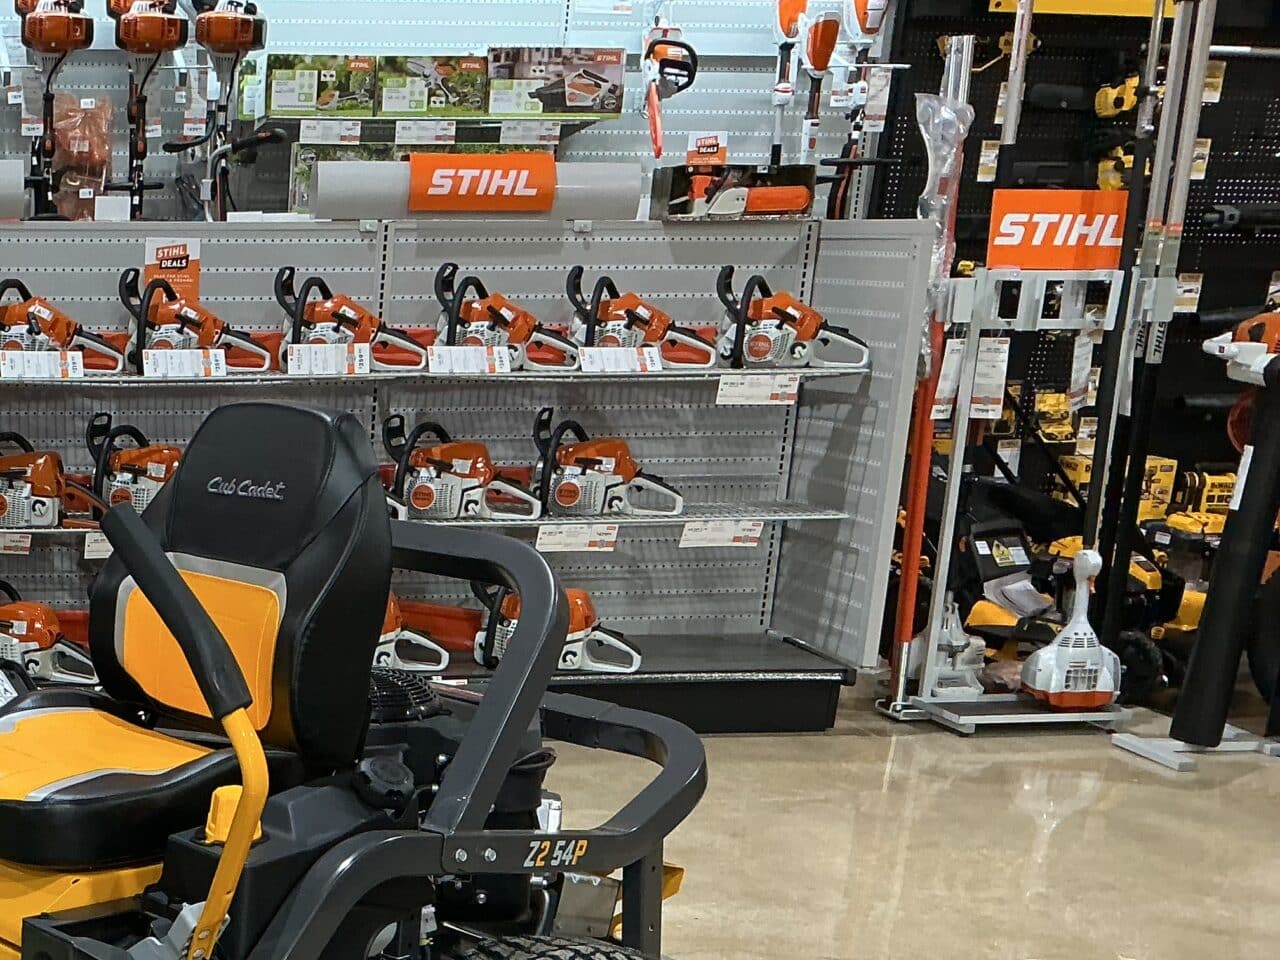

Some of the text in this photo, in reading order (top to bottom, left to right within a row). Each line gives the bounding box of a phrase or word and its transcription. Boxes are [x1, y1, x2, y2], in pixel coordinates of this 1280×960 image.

[427, 169, 538, 196] STIHL
[993, 213, 1123, 246] STIHL
[157, 246, 185, 258] STIHL
[161, 259, 187, 268] DEALS
[207, 476, 286, 499] Cub Cadet
[523, 839, 588, 867] Z2 54P
